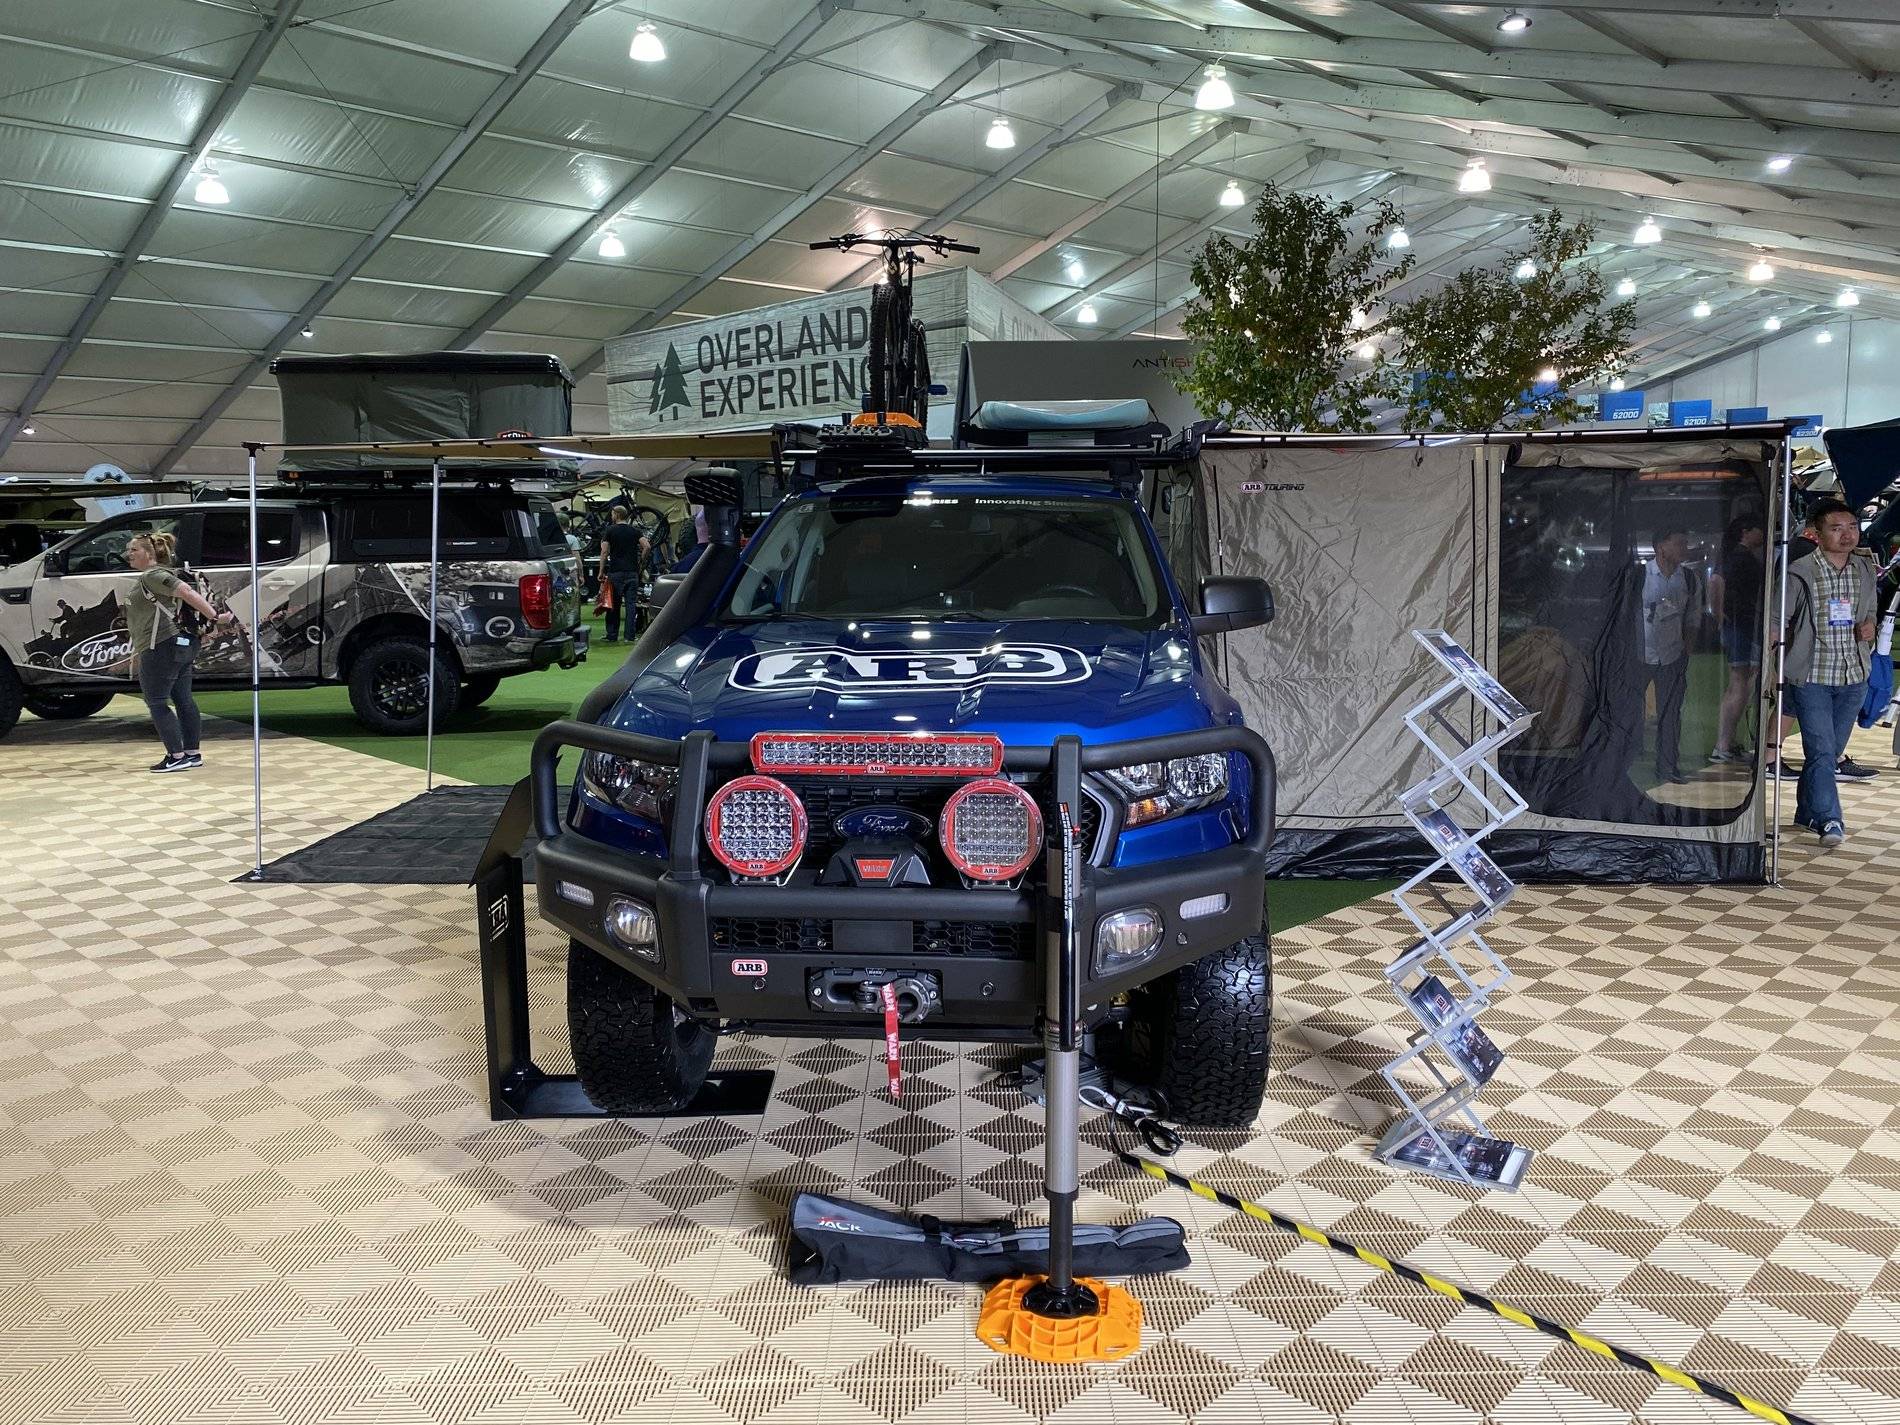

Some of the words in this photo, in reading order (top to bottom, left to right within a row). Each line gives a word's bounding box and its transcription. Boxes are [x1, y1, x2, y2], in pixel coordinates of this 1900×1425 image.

[697, 306, 868, 374] OVERLAND
[975, 498, 1041, 506] Innovating
[758, 648, 1064, 683] ARB
[862, 814, 910, 833] Ford
[737, 963, 763, 972] ARB
[881, 982, 896, 1012] WARN
[886, 1031, 898, 1061] WARN
[818, 1220, 865, 1233] JACK
